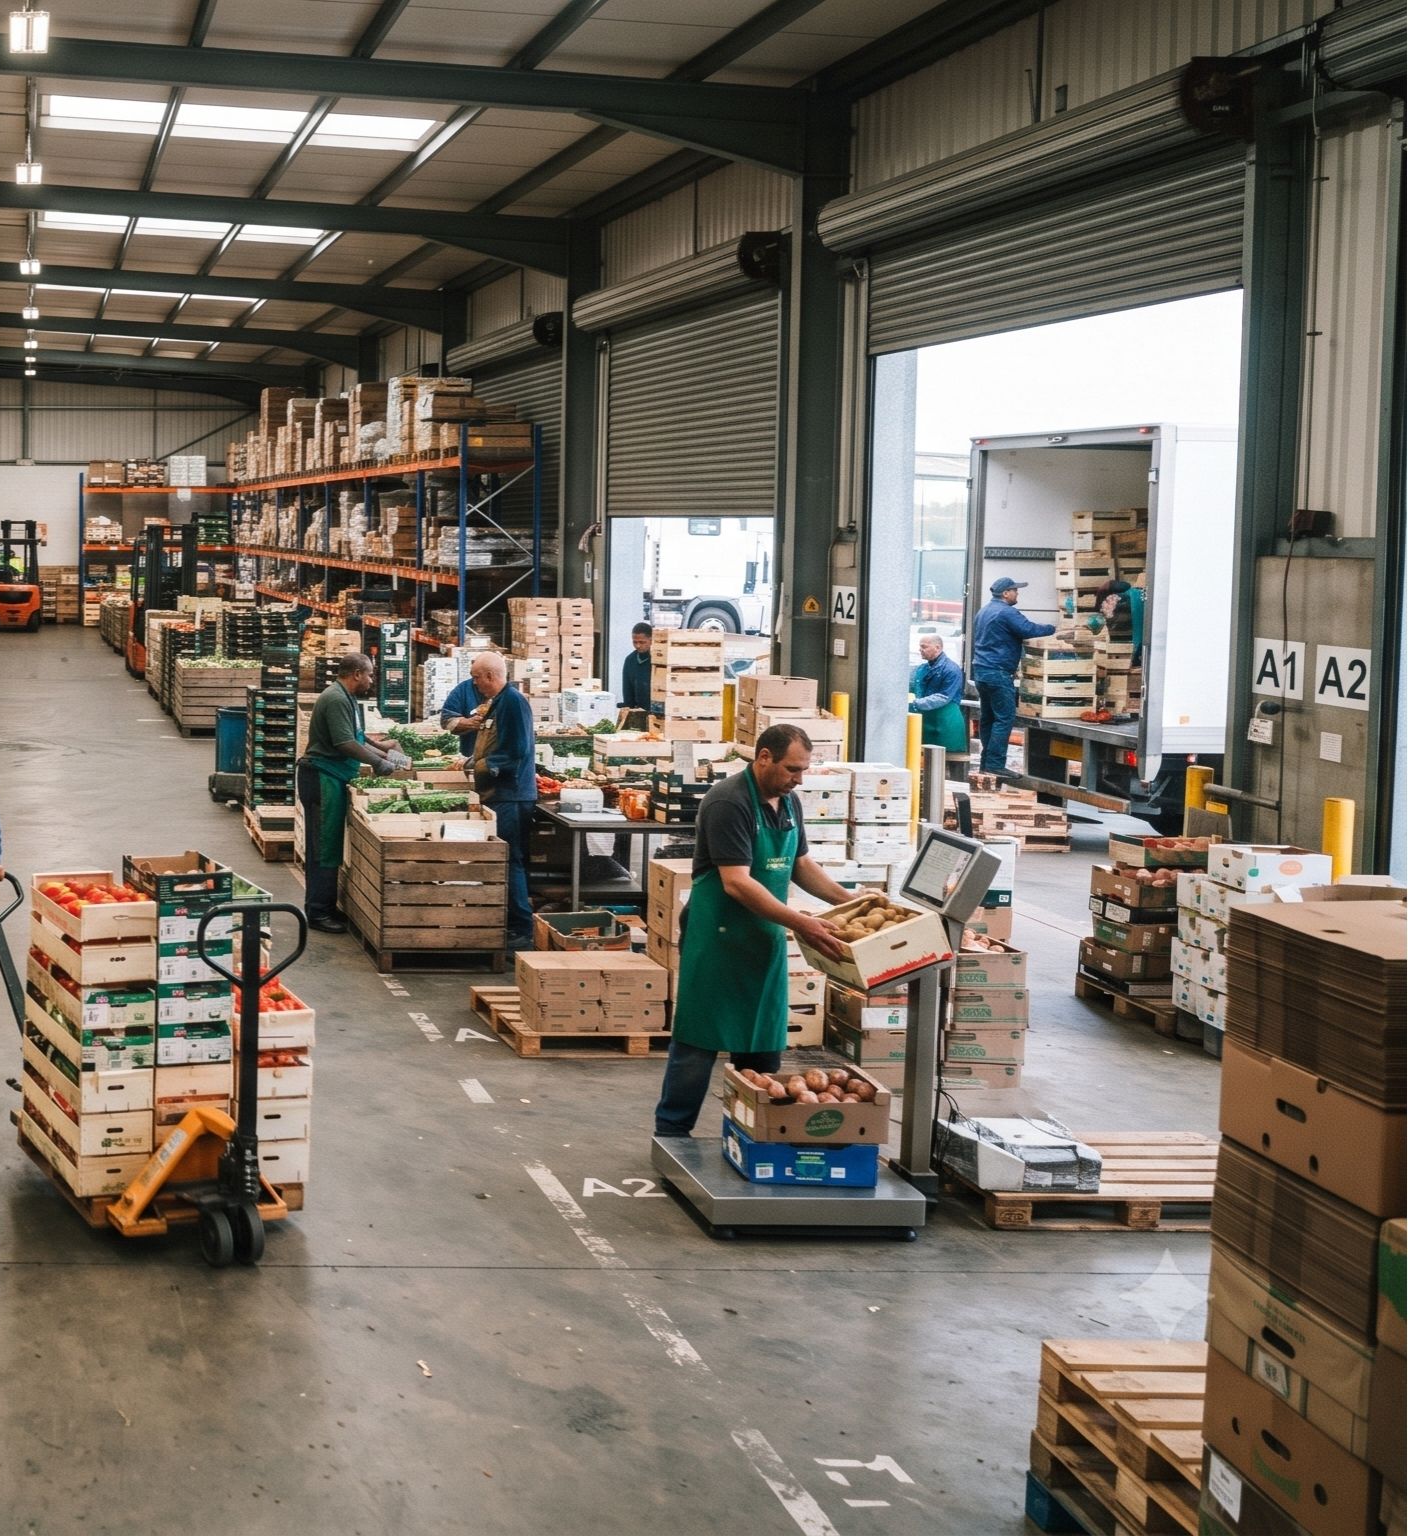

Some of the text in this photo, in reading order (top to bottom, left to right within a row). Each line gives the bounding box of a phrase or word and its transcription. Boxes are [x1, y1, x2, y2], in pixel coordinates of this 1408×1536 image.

[833, 591, 855, 620] A2
[1256, 648, 1296, 691] A1
[1318, 656, 1367, 701] A2
[582, 1177, 668, 1197] A2
